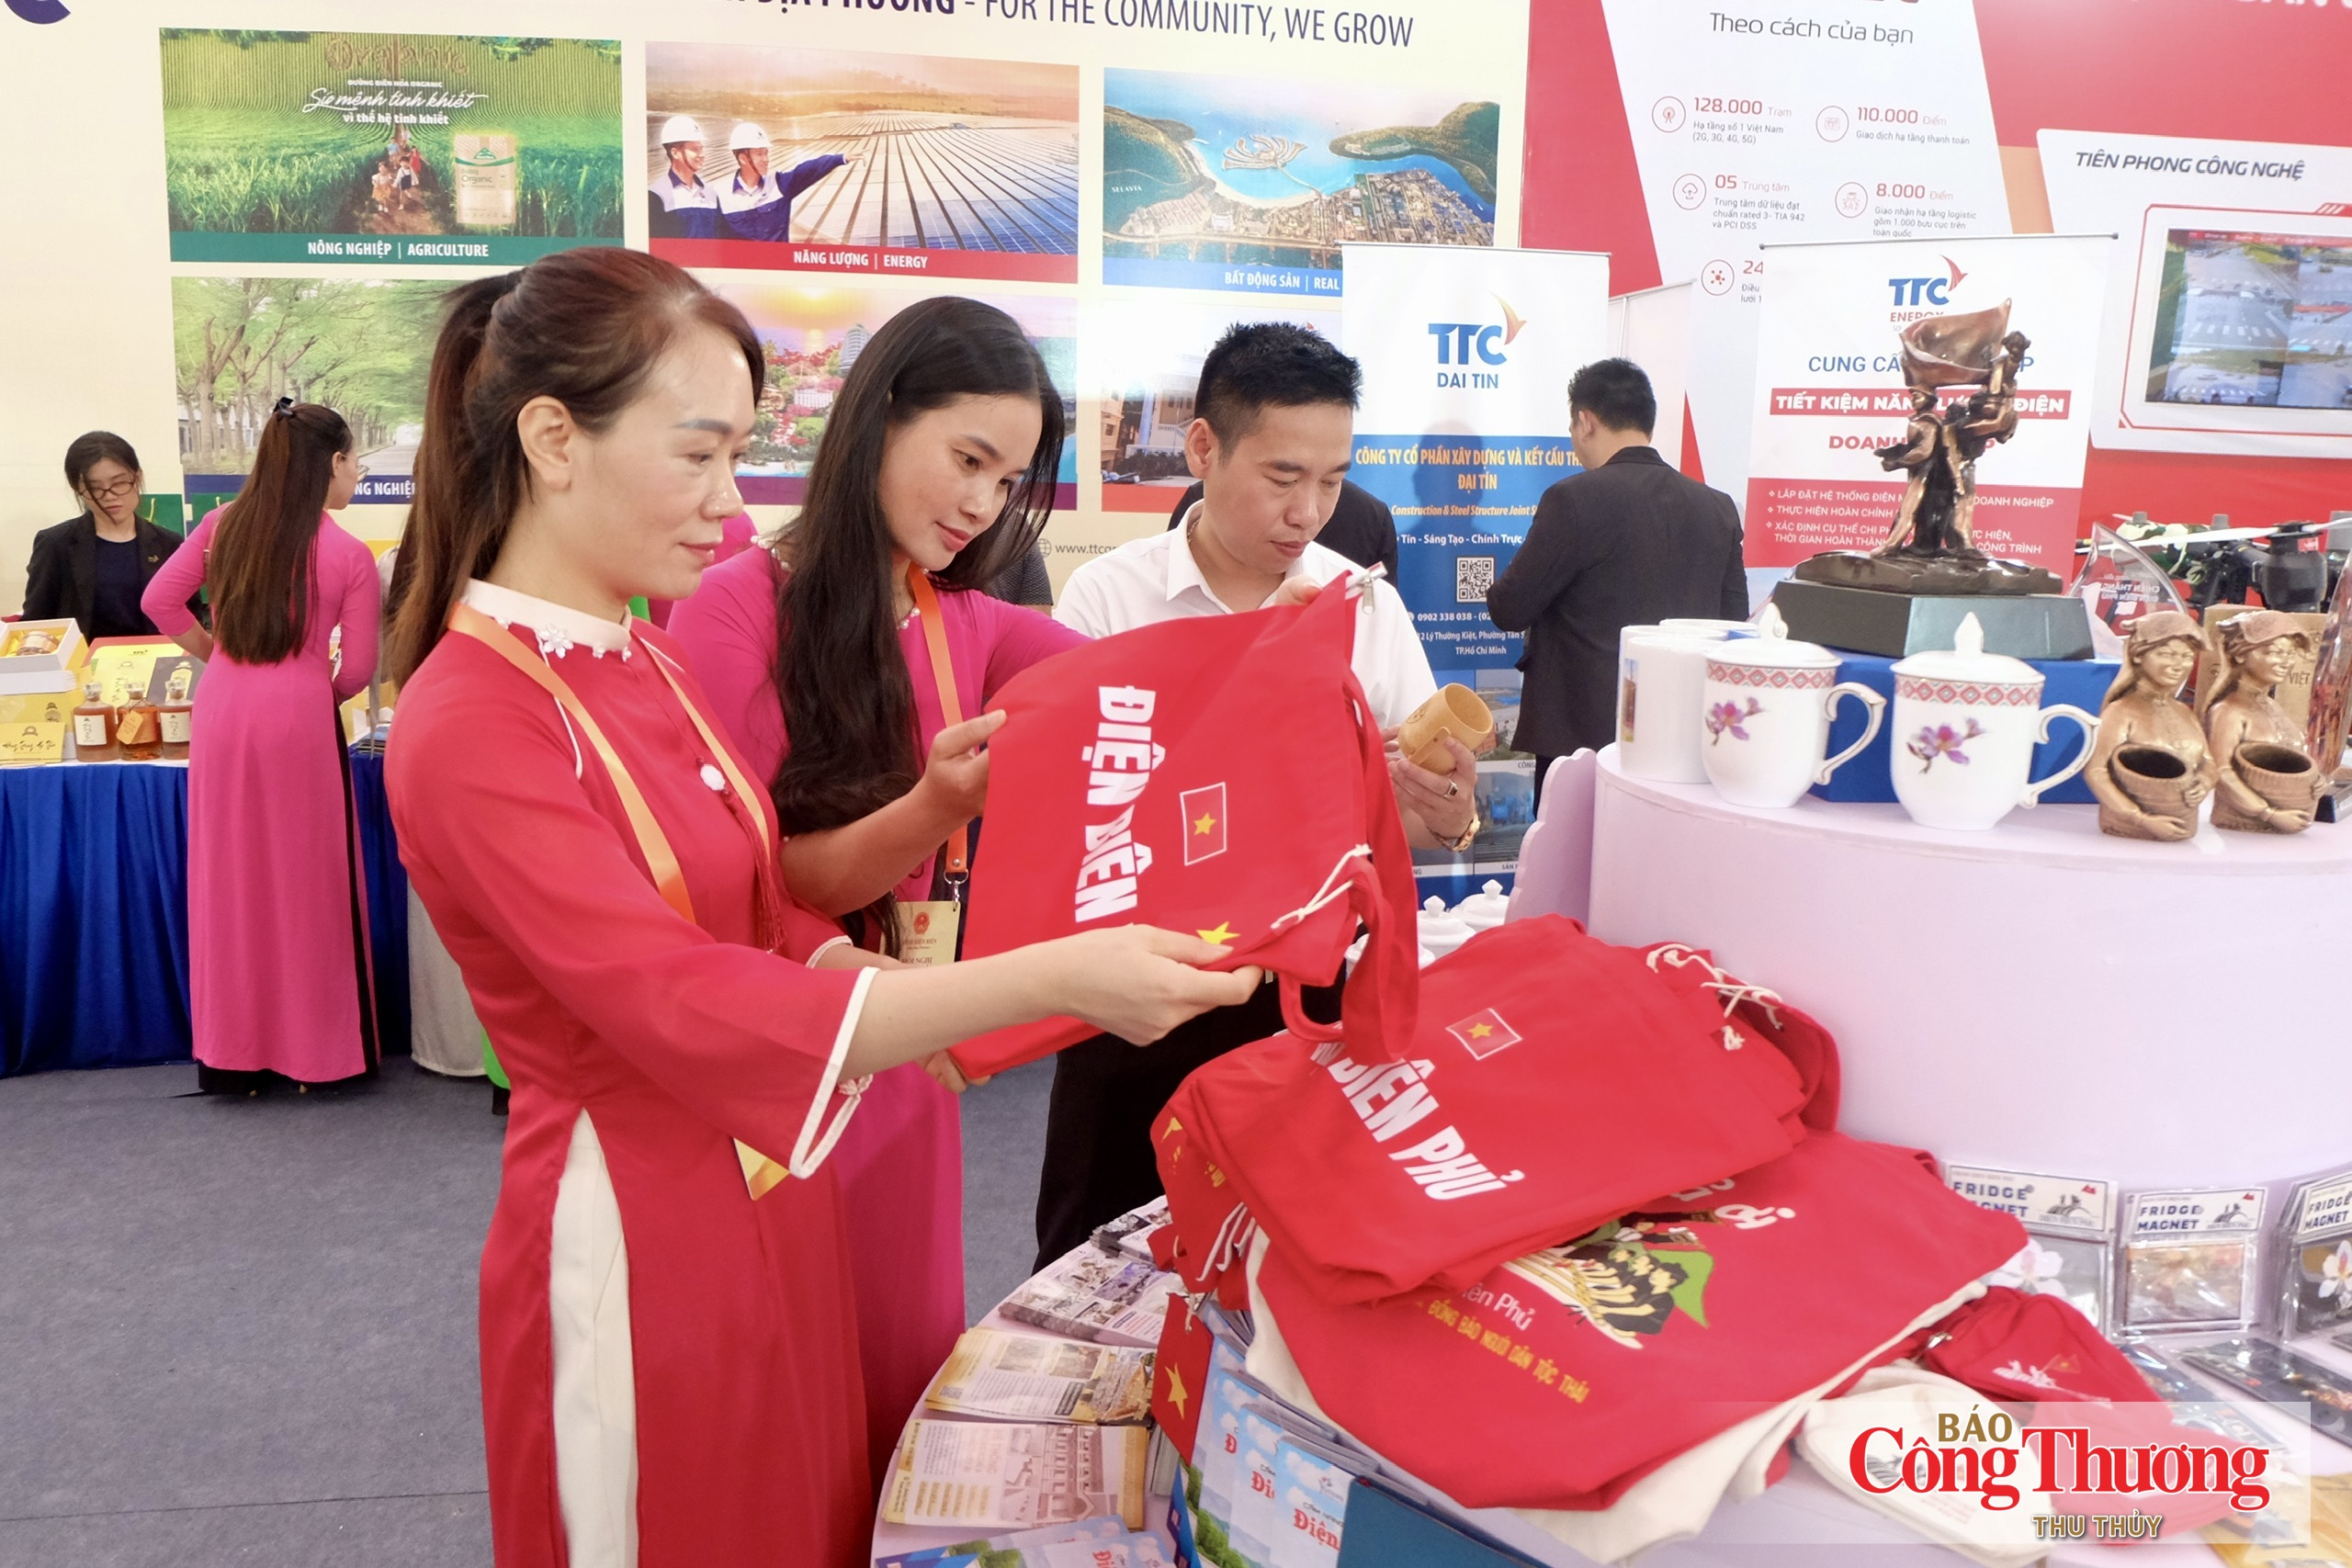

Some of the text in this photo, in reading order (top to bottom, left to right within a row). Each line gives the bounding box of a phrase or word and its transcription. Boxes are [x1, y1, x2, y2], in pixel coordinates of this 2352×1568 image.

[1049, 0, 1413, 47] THE COMMUNITY, WE GROW
[1710, 12, 1914, 46] Theo cách của bạn
[325, 37, 469, 77] Organic
[411, 80, 443, 88] ORGANIC
[426, 90, 489, 107] khiết
[1694, 96, 1763, 115] 128.000
[356, 110, 448, 125] thế tinh khiết
[1858, 107, 1947, 125] 110.000 Điểm
[1693, 120, 1784, 133] Hạ tầng Việt Nam
[1692, 132, 1757, 144] (2G, 3G, 4G, 5G)
[1856, 130, 1970, 145] Giao dịch tầng thanh toán
[2075, 149, 2305, 181] TIÊN PHONG CÔNG NGHỆ
[461, 175, 492, 184] Organic
[1715, 175, 1790, 193] 05 Trung tâm
[1876, 183, 1953, 200] 8.000 Điểm
[1714, 197, 1800, 211] Trung tâm liệu đạt
[1713, 209, 1805, 221] chuẩn rated TIA 942
[1874, 207, 1976, 220] Giao nhận tầng logistic
[1724, 220, 1738, 229] PCI
[1740, 221, 1757, 230] DSS
[1873, 217, 1966, 230] gồm 1.000 cục trên
[1872, 228, 1912, 239] toàn quốc
[308, 240, 489, 258] NÔNG NGHIỆP AGRICULTURE
[794, 250, 928, 268] NĂNG LƯỢNG ENERGY
[1225, 269, 1340, 290] BẤT ĐỘNG SẢN REAL
[1741, 284, 1760, 293] Điều
[1889, 277, 1950, 306] TTC
[1428, 323, 1507, 366] TTC
[1808, 356, 1866, 373] CUNG
[1437, 372, 1498, 389] DAI TIN
[1776, 390, 2064, 416] TIẾT KIỆM ĐIỆN
[1355, 443, 1565, 470] CÔNG TY CỔ PHẦN XÂY DỰNG VÀ KẾT CẤU
[1458, 469, 1498, 493] ĐẠI TÍN
[1778, 490, 1796, 499] LẮP
[1798, 489, 1818, 502] ĐẶT
[1819, 491, 1833, 501] HỆ
[1837, 490, 1869, 502] THỐNG
[1871, 491, 1896, 502] ĐIỆN
[1973, 496, 2010, 506] DOANH
[2013, 496, 2053, 509] NGHIỆP
[1391, 504, 1531, 516] Construction & Steel Structure Joint
[1777, 505, 1859, 516] THỰC HIỆN HOÀN
[1775, 522, 1794, 531] XÁC
[1796, 522, 1820, 533] ĐỊNH
[1823, 523, 1837, 535] CỤ
[1860, 525, 1877, 535] CHI
[1984, 529, 2012, 540] HIỆN,
[1402, 534, 1521, 546] Tín Sáng Tạo Chính Trực
[1774, 533, 2041, 554] THỜI GIAN HOÀN CÔNG TRÌNH
[1417, 613, 1472, 621] 0902 338 038
[1434, 630, 1520, 642] Thường Phường Tân
[1455, 646, 1475, 655] TP.Hồ
[1081, 685, 1166, 805] ĐIỆN
[1388, 1124, 1525, 1200] PHỦ
[1953, 1181, 2027, 1200] FRIDGE
[2140, 1205, 2199, 1216] FRIDGE
[2308, 1191, 2350, 1214] FRIDGE
[2137, 1219, 2199, 1231] MAGNET
[2304, 1211, 2349, 1230] MAGNET
[1493, 1292, 1536, 1331] Phủ
[1293, 1506, 1340, 1551] Điện
